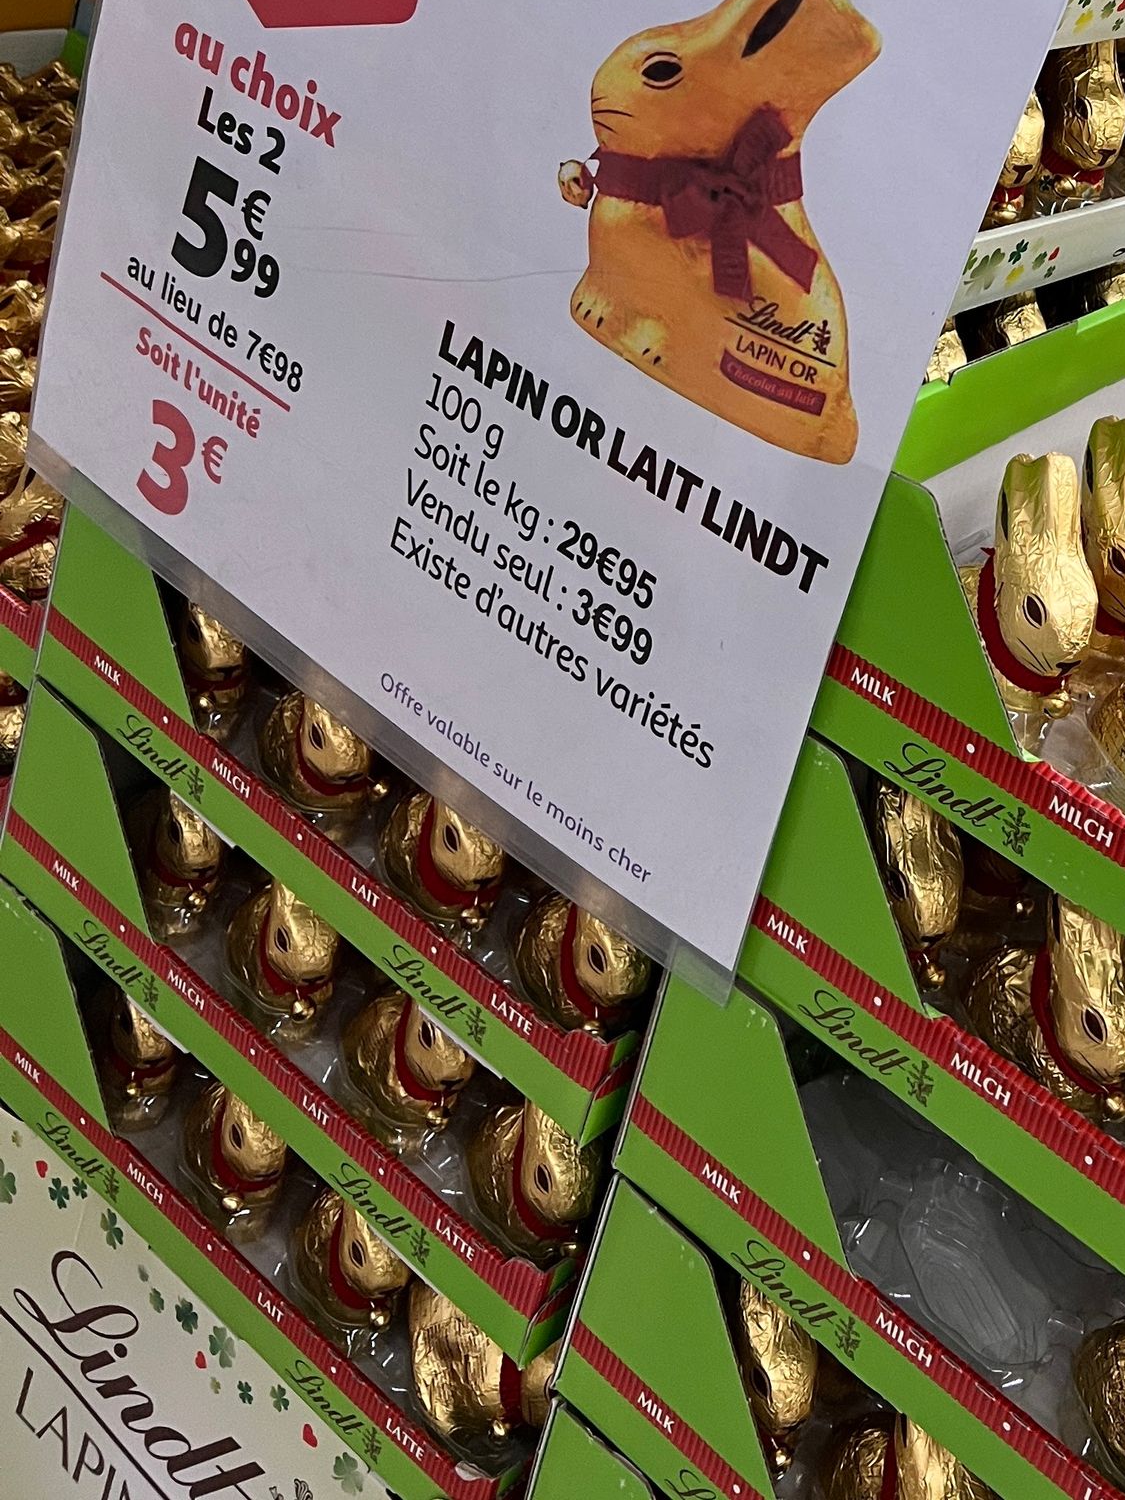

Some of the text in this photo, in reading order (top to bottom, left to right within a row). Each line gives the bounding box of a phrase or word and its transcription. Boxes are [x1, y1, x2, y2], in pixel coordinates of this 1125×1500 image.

[174, 22, 342, 148] au choix
[197, 86, 286, 174] Les 2
[127, 256, 303, 393] au lieu de 7€98
[135, 326, 262, 438] Soit l'unité
[424, 373, 505, 459] 100 g
[438, 320, 829, 594] LAPIN OR LAIT LINDT
[414, 424, 656, 610] Soit le kg 29€95
[405, 469, 655, 666] Vendu seul 3€99
[93, 655, 122, 686] MILK
[390, 516, 715, 770] Existe d'autres variétés
[850, 666, 896, 707] MILK
[116, 714, 187, 781] Lindt
[211, 757, 252, 800] MILCH
[379, 672, 652, 884] Offre valable sur le moins cher
[1047, 795, 1115, 848] MILCH
[766, 913, 809, 954] MILK
[490, 992, 533, 1036] LATTE
[329, 1162, 413, 1239] Lindt
[13, 1250, 266, 1500] Lindt
